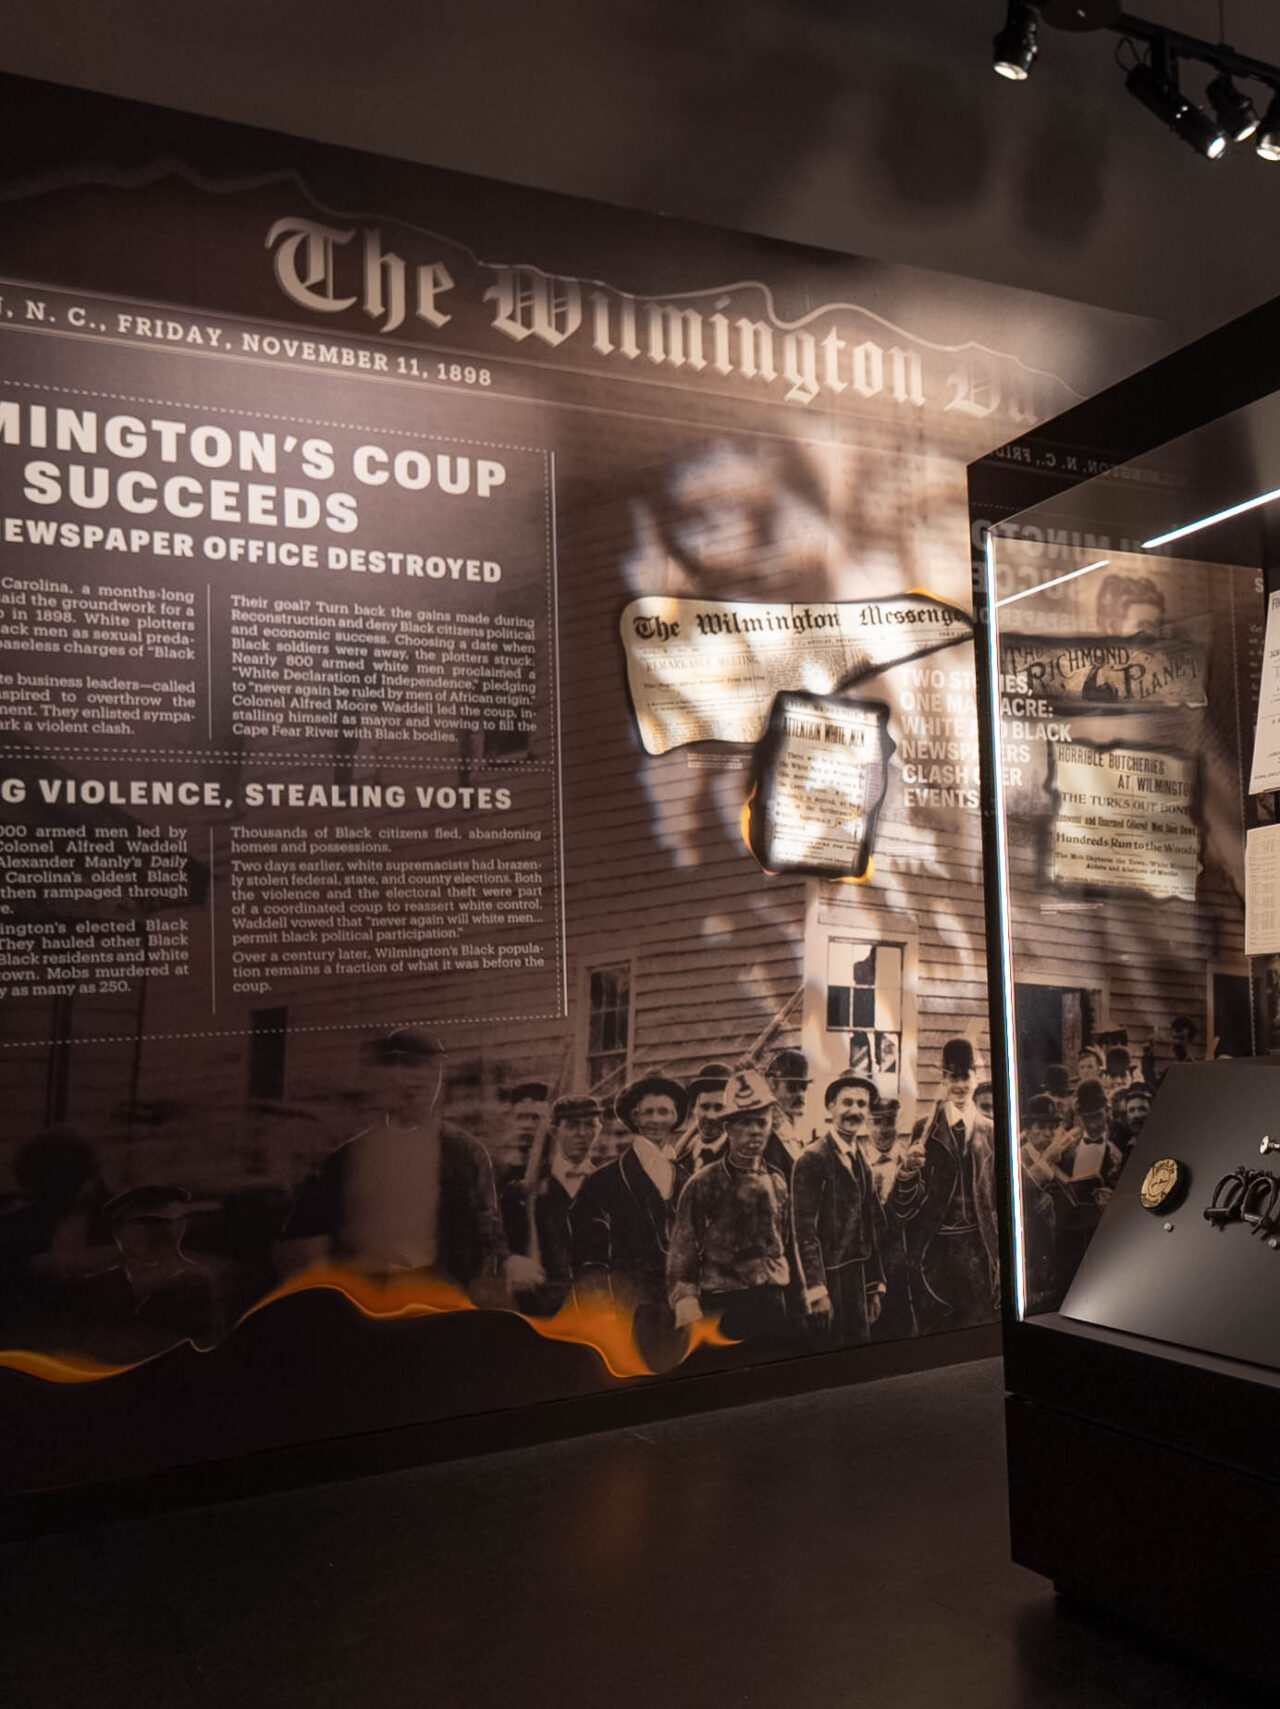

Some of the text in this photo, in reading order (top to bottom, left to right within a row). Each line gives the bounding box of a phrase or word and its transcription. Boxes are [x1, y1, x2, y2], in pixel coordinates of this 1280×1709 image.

[265, 215, 455, 334] The
[483, 266, 928, 407] Wilmington
[26, 300, 56, 322] N.
[117, 314, 232, 350] FRIDAY,
[241, 332, 389, 373] NOVEMBER
[396, 356, 429, 380] 11,
[437, 361, 493, 387] 1898
[352, 445, 507, 498] COUP
[22, 460, 360, 534] SUCCEEDS
[203, 535, 320, 569] OFFICE
[327, 548, 503, 584] DESTROYED
[31, 594, 194, 616] the groundwork for a
[81, 584, 90, 594] a
[98, 583, 194, 603] months-long
[12, 607, 27, 620] in
[84, 612, 129, 626] White
[137, 615, 194, 633] plotters
[230, 593, 267, 608] Their
[315, 599, 348, 614] Turn
[354, 602, 384, 616] back
[391, 605, 411, 618] the
[417, 607, 450, 624] gains
[456, 610, 489, 624] made
[494, 613, 534, 630] during
[231, 608, 534, 643] Reconstruction and deny Black citizens political
[633, 615, 682, 642] The
[696, 608, 841, 636] Wilmington
[231, 622, 257, 635] and
[263, 624, 330, 640] economic
[394, 632, 454, 650] Choosing
[459, 639, 466, 648] a
[471, 637, 497, 650] date
[502, 639, 535, 652] when
[900, 668, 1033, 696] TWO STIES,
[1018, 646, 1131, 693] RICHMOND
[1114, 658, 1199, 700] PLANET
[900, 691, 1054, 719] ONE MAACRE:
[232, 722, 268, 739] Cape
[272, 723, 300, 736] Fear
[305, 724, 338, 737] River
[342, 726, 371, 738] with
[375, 727, 409, 739] Black
[900, 715, 967, 738] WHITE
[1012, 721, 1073, 743] BLACK
[902, 763, 968, 785] CLASH
[1058, 746, 1165, 775] HORRIBLE BUTCHERIES
[38, 779, 233, 809] VIOLENCE,
[244, 782, 406, 810] STEALING
[415, 785, 513, 811] VOTES
[1117, 775, 1131, 789] AT
[903, 787, 979, 809] EVENTS
[1061, 792, 1086, 805] THE
[1090, 795, 1130, 809] TURKS
[1132, 800, 1156, 813] OUT
[1056, 832, 1110, 847] Hundreds
[1111, 837, 1132, 850] Run
[1134, 840, 1145, 850] to
[1145, 839, 1163, 852] the
